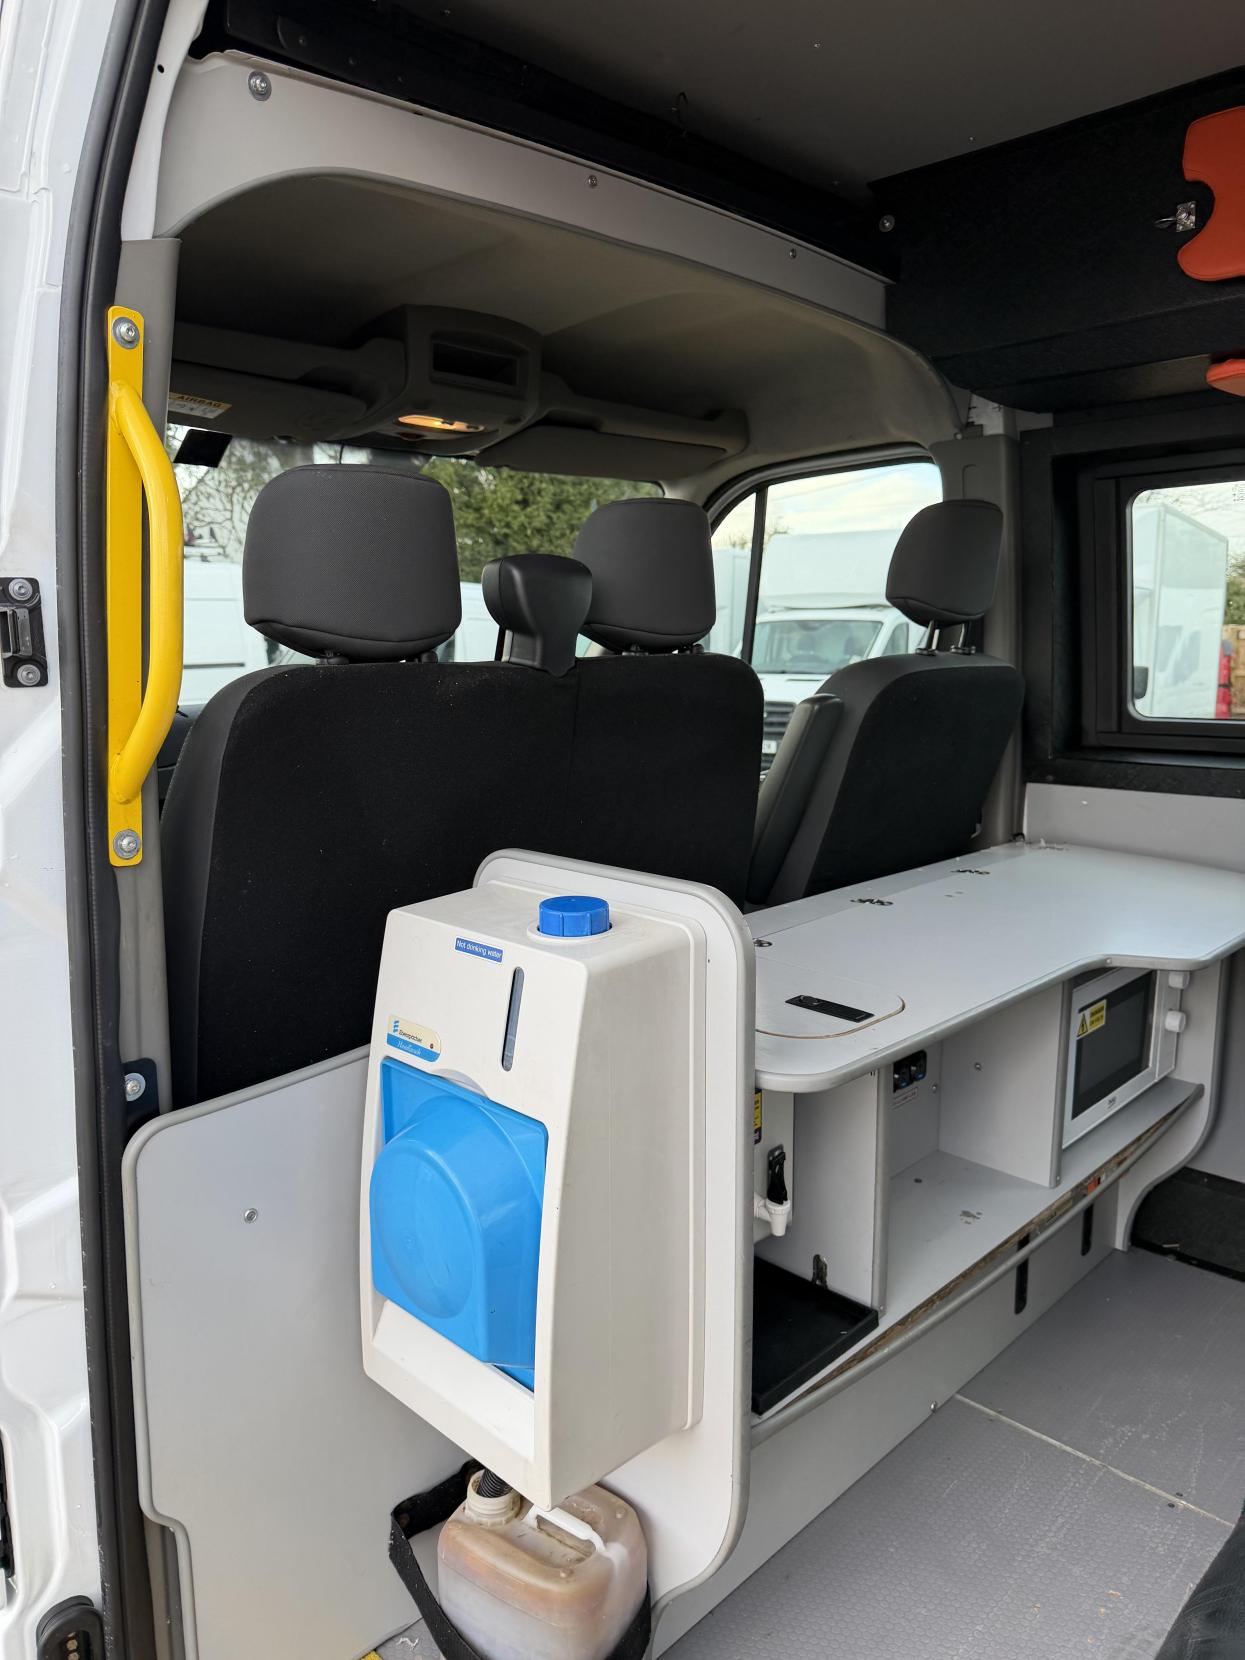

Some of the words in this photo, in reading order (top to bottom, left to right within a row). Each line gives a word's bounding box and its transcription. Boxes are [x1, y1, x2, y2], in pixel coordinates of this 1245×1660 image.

[456, 940, 466, 949] Not
[466, 944, 487, 956] drinking
[487, 950, 502, 959] water
